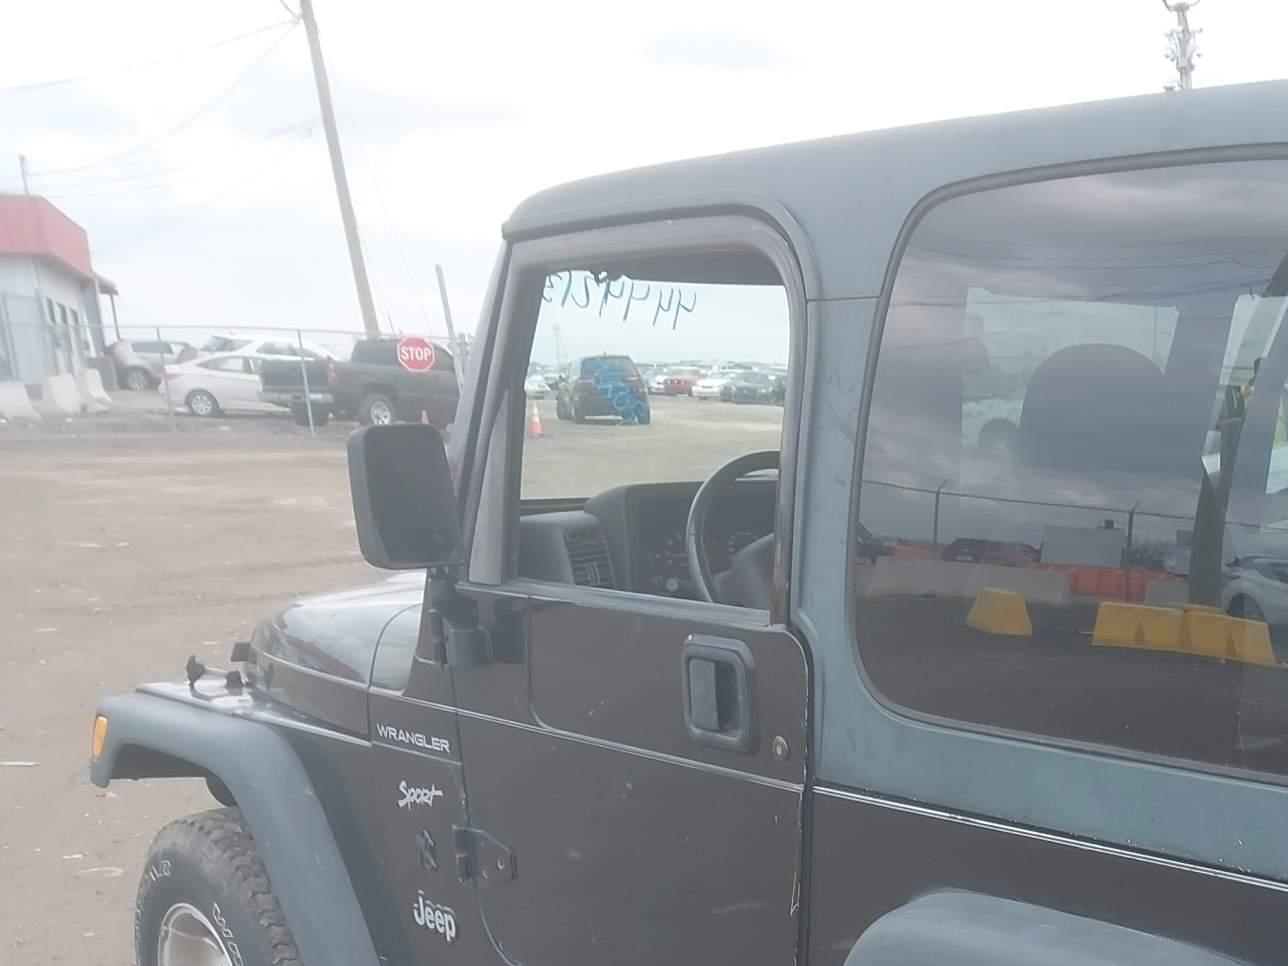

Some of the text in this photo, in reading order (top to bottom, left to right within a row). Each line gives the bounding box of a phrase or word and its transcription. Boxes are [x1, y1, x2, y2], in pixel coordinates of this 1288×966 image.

[400, 346, 432, 361] STOP
[376, 722, 451, 753] WRANGLER
[412, 889, 457, 941] Jeep
